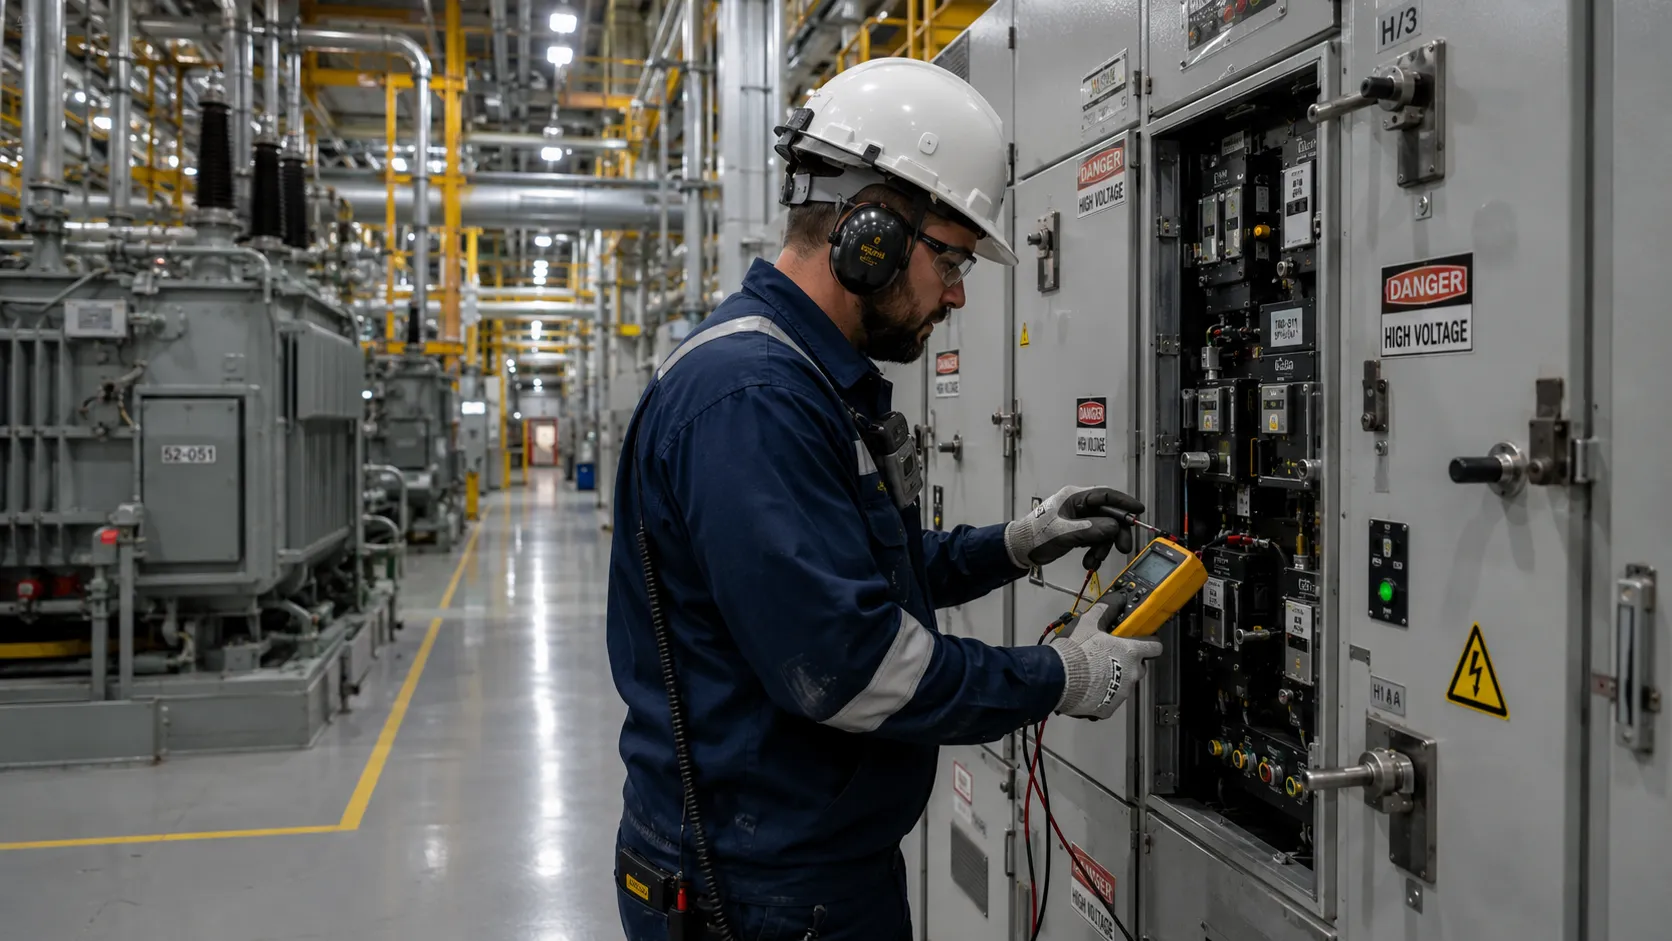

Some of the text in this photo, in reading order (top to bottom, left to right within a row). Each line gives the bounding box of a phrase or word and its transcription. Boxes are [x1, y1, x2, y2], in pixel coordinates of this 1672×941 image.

[1382, 6, 1417, 45] H/3
[1081, 151, 1121, 182] DANGER
[1078, 182, 1124, 214] HIGH VOLTAGE
[1390, 270, 1463, 300] DANGER
[1384, 319, 1468, 349] HIGH VOLTAGE
[163, 447, 213, 461] 52-051
